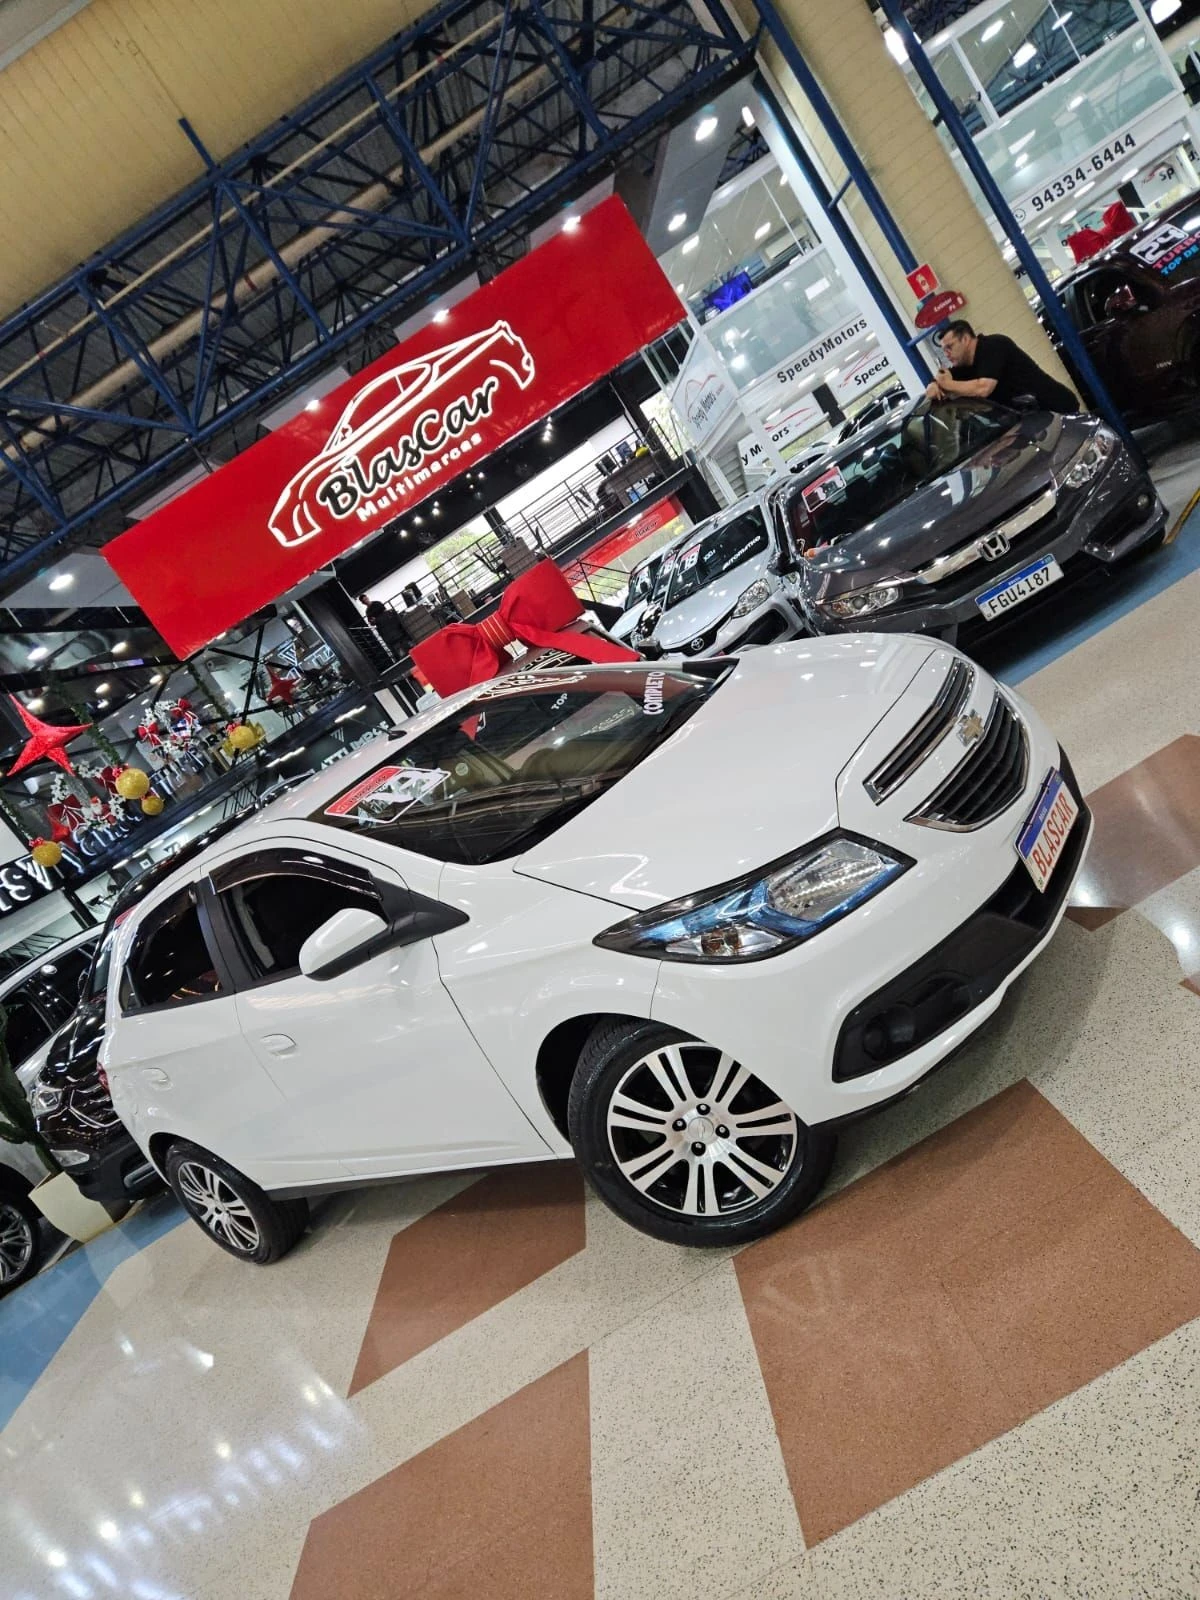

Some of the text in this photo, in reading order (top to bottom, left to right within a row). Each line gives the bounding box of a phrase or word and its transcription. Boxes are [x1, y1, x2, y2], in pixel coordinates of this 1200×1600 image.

[1031, 133, 1137, 212] 94334-6444
[777, 319, 868, 383] SpeedyMotors
[316, 377, 500, 520] BlasCar
[356, 432, 483, 521] Multimarcas
[988, 567, 1051, 614] FGU4I87
[551, 692, 568, 710] TOP
[643, 671, 666, 716] COMPLETO
[1032, 792, 1074, 878] BLASCAR
